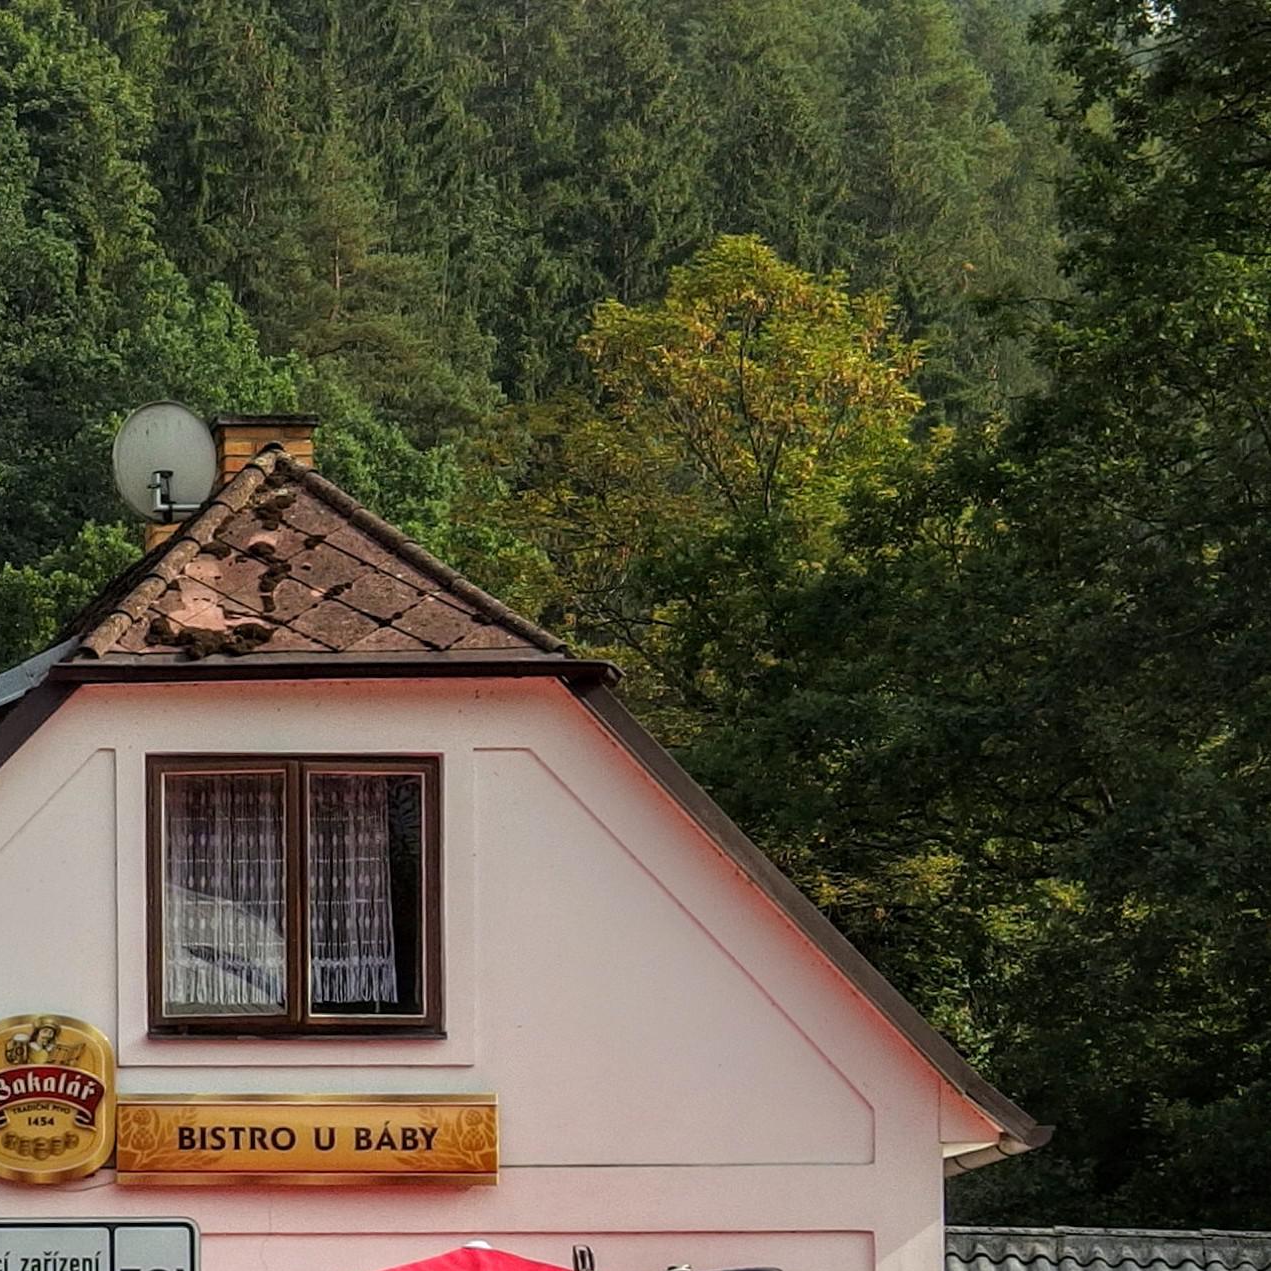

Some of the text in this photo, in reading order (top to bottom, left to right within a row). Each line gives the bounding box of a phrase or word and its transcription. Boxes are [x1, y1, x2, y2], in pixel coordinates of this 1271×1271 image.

[27, 1116, 55, 1127] 1454
[177, 1118, 439, 1152] BISTRO U BÁBY
